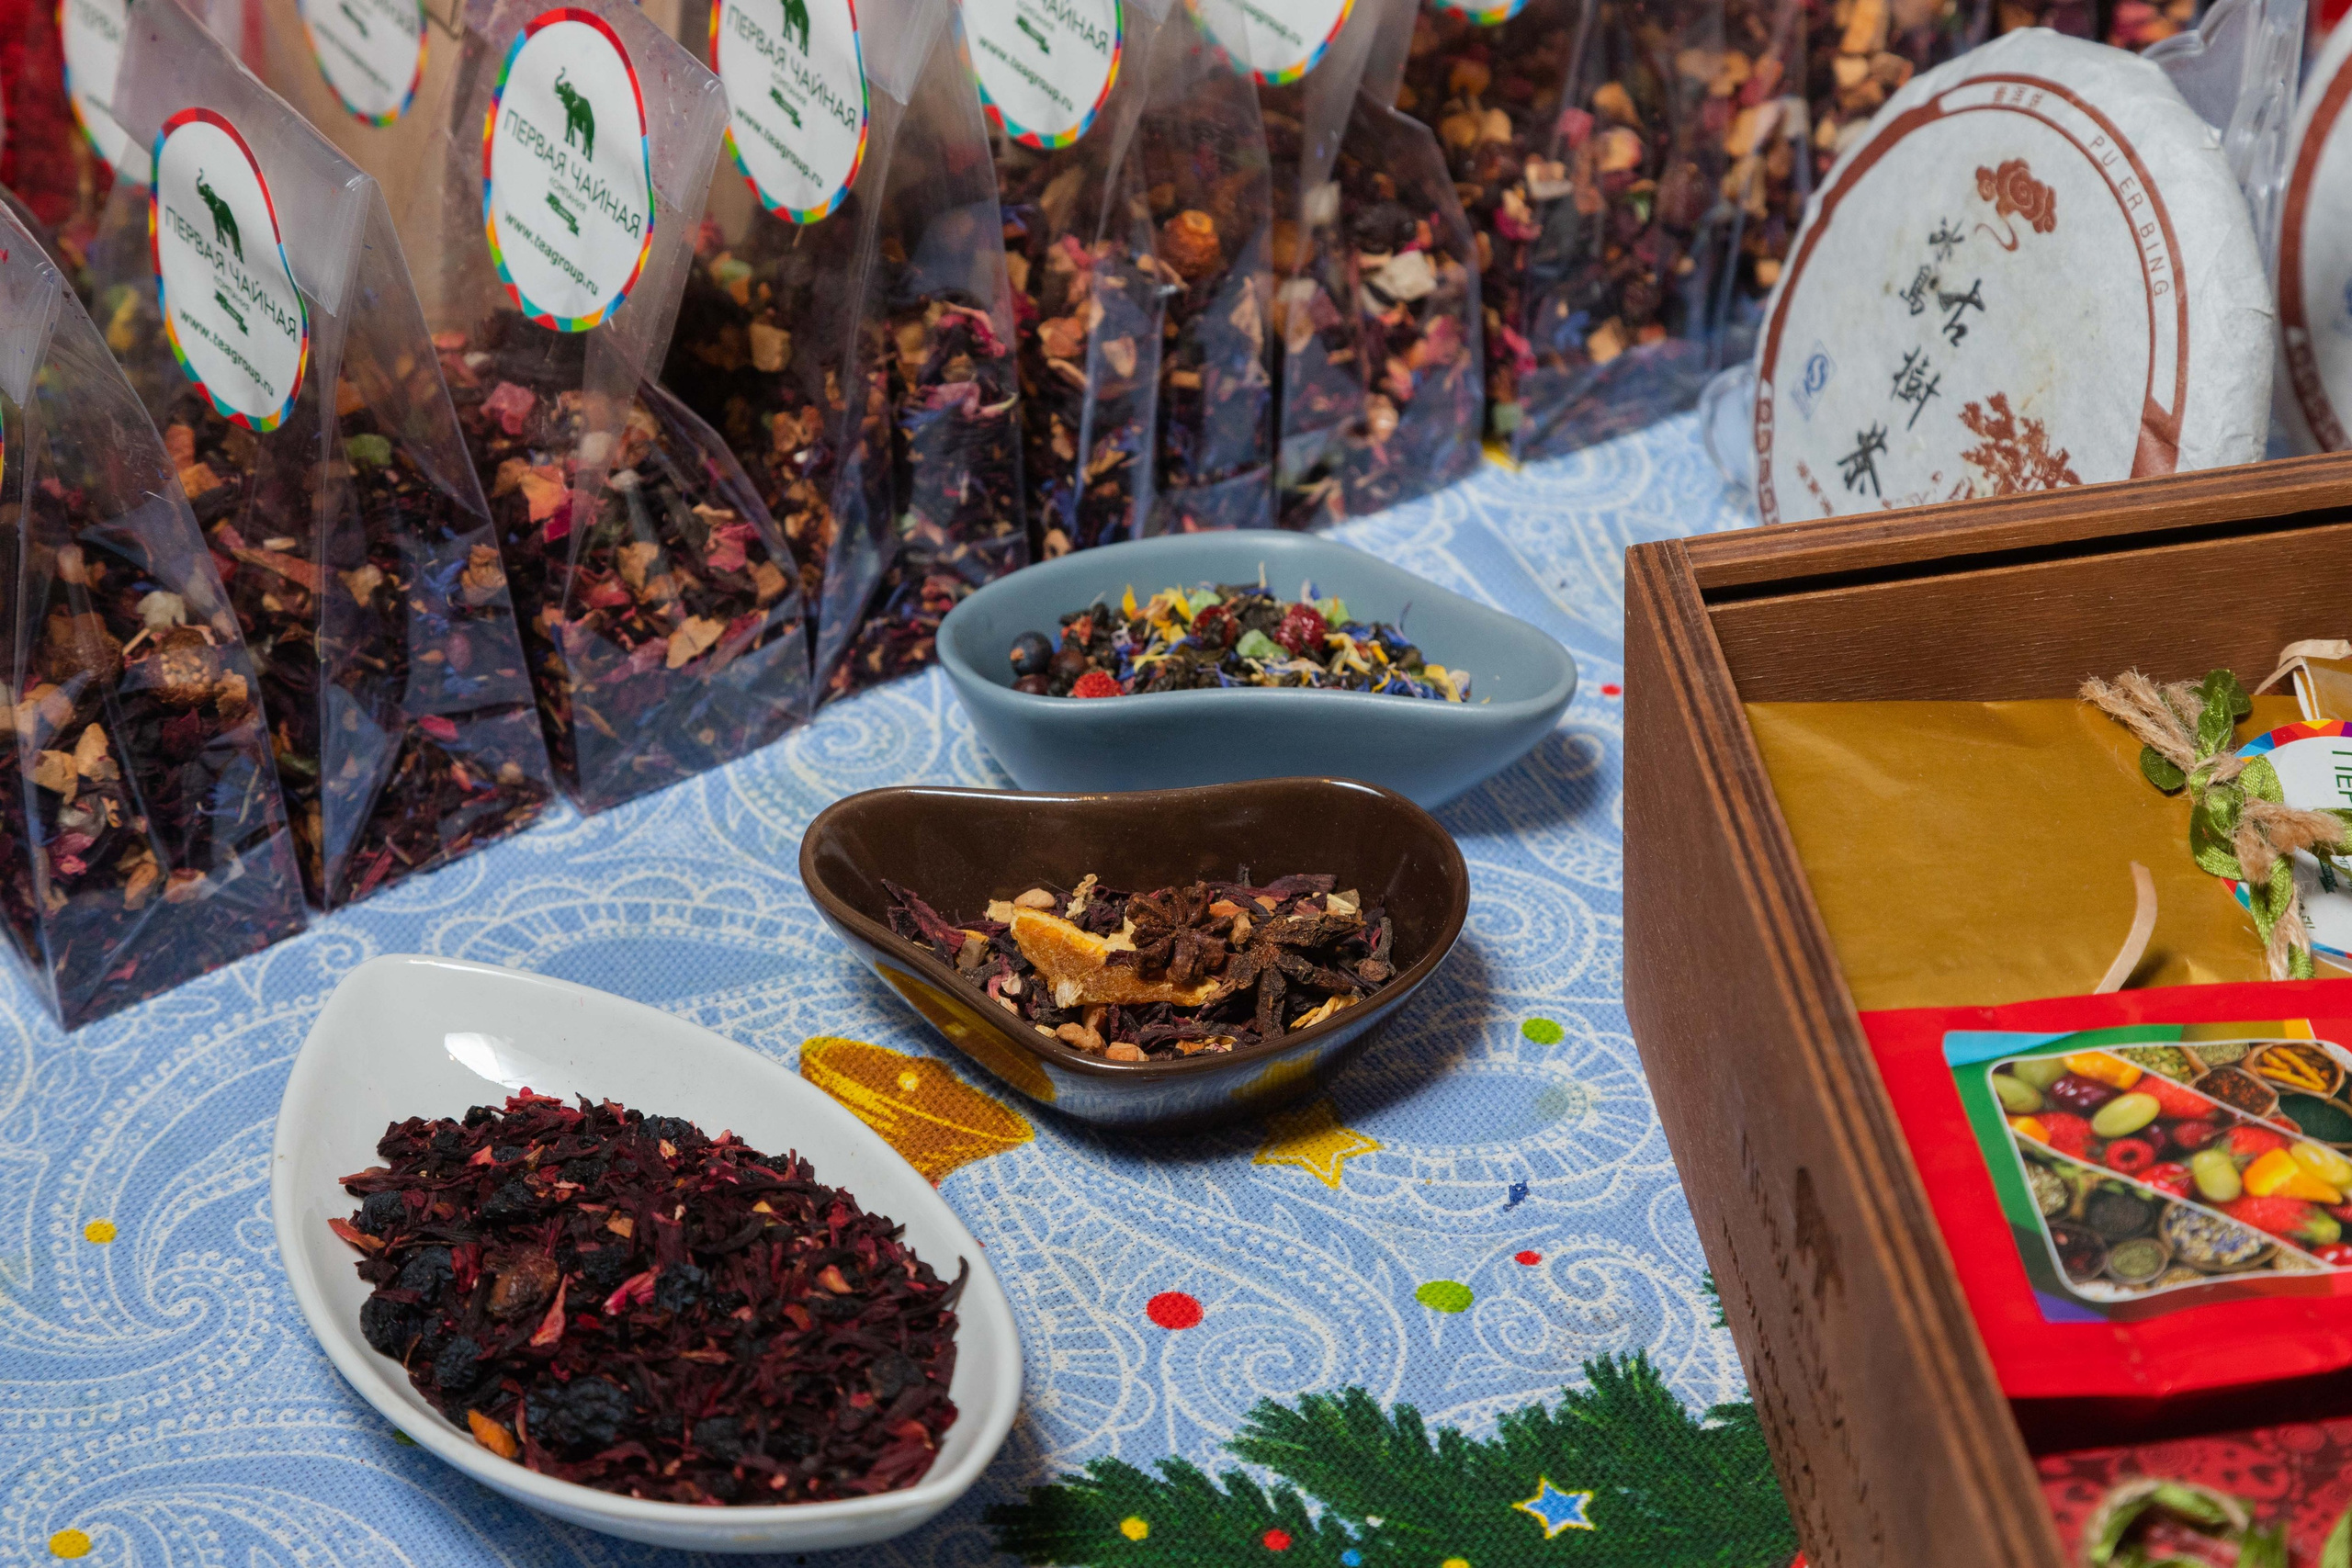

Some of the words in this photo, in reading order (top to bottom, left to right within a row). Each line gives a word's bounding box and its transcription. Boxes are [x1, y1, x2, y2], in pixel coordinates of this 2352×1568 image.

[726, 5, 786, 71] ПЕРВАЯ
[790, 56, 857, 132] ЧАЙНАЯ
[1042, 0, 1109, 55] АЙНАЯ
[503, 107, 567, 177] ПЕРВАЯ
[571, 161, 642, 240] ЧАЙНАЯ
[735, 105, 823, 189] www.teagroup.ru
[504, 209, 599, 297] www.teagroup.ru
[2088, 135, 2120, 168] PU
[2119, 176, 2144, 212] ER
[2139, 221, 2170, 298] BING
[164, 204, 226, 276] ПЕРВАЯ
[230, 266, 297, 343] ЧАЙНАЯ
[179, 308, 275, 398] www.teagroup.ru
